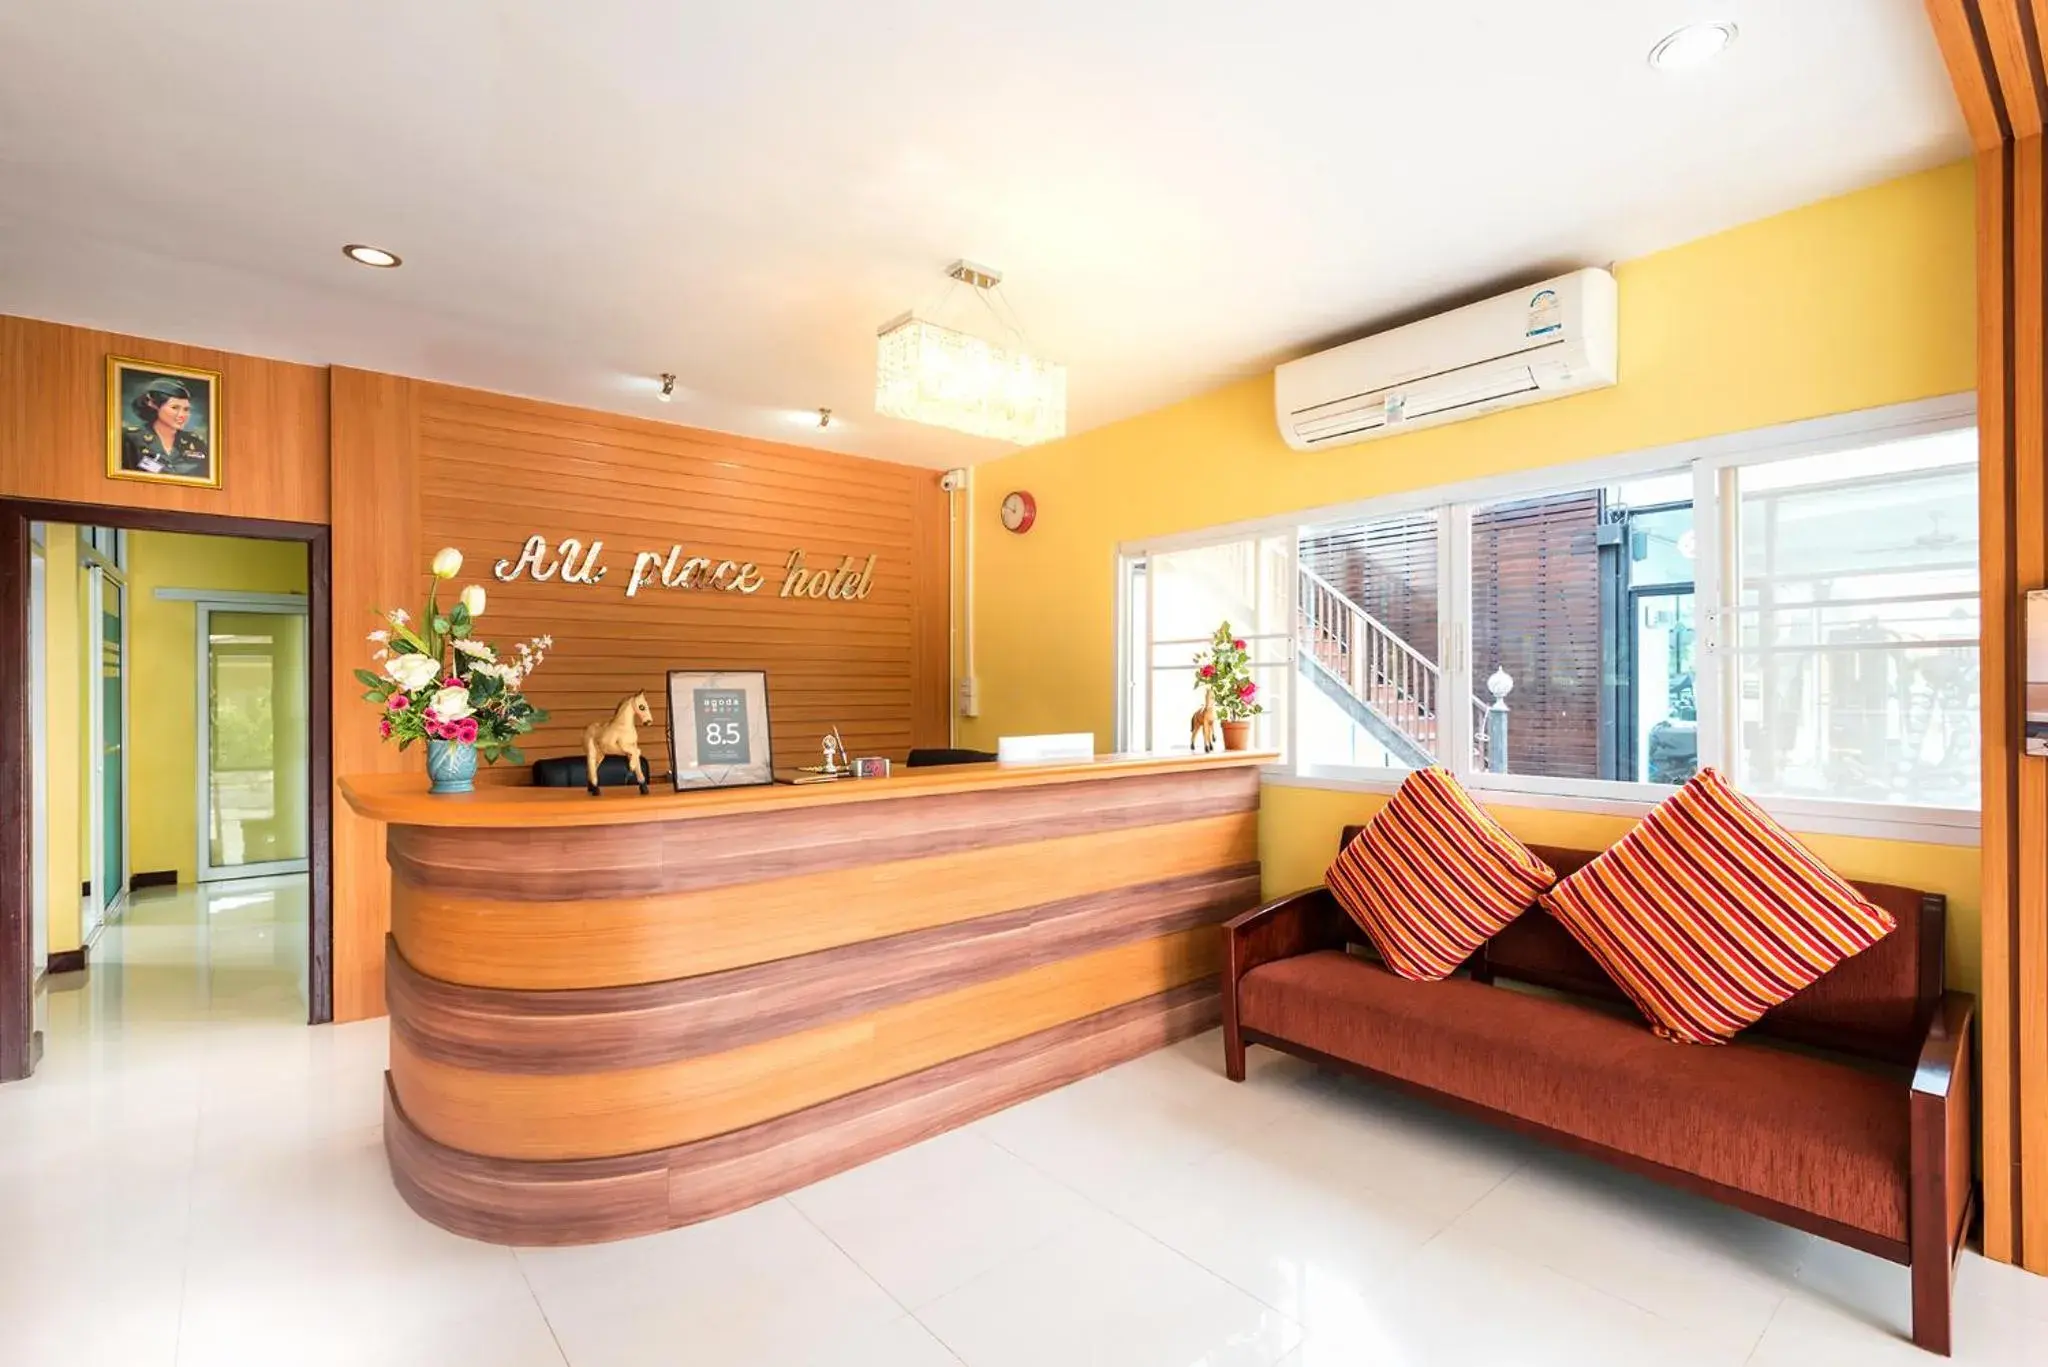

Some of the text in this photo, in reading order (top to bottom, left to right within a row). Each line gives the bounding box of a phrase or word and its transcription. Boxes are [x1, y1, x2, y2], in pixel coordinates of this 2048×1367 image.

[495, 535, 878, 600] AU place hotel
[706, 722, 741, 745] 8.5
